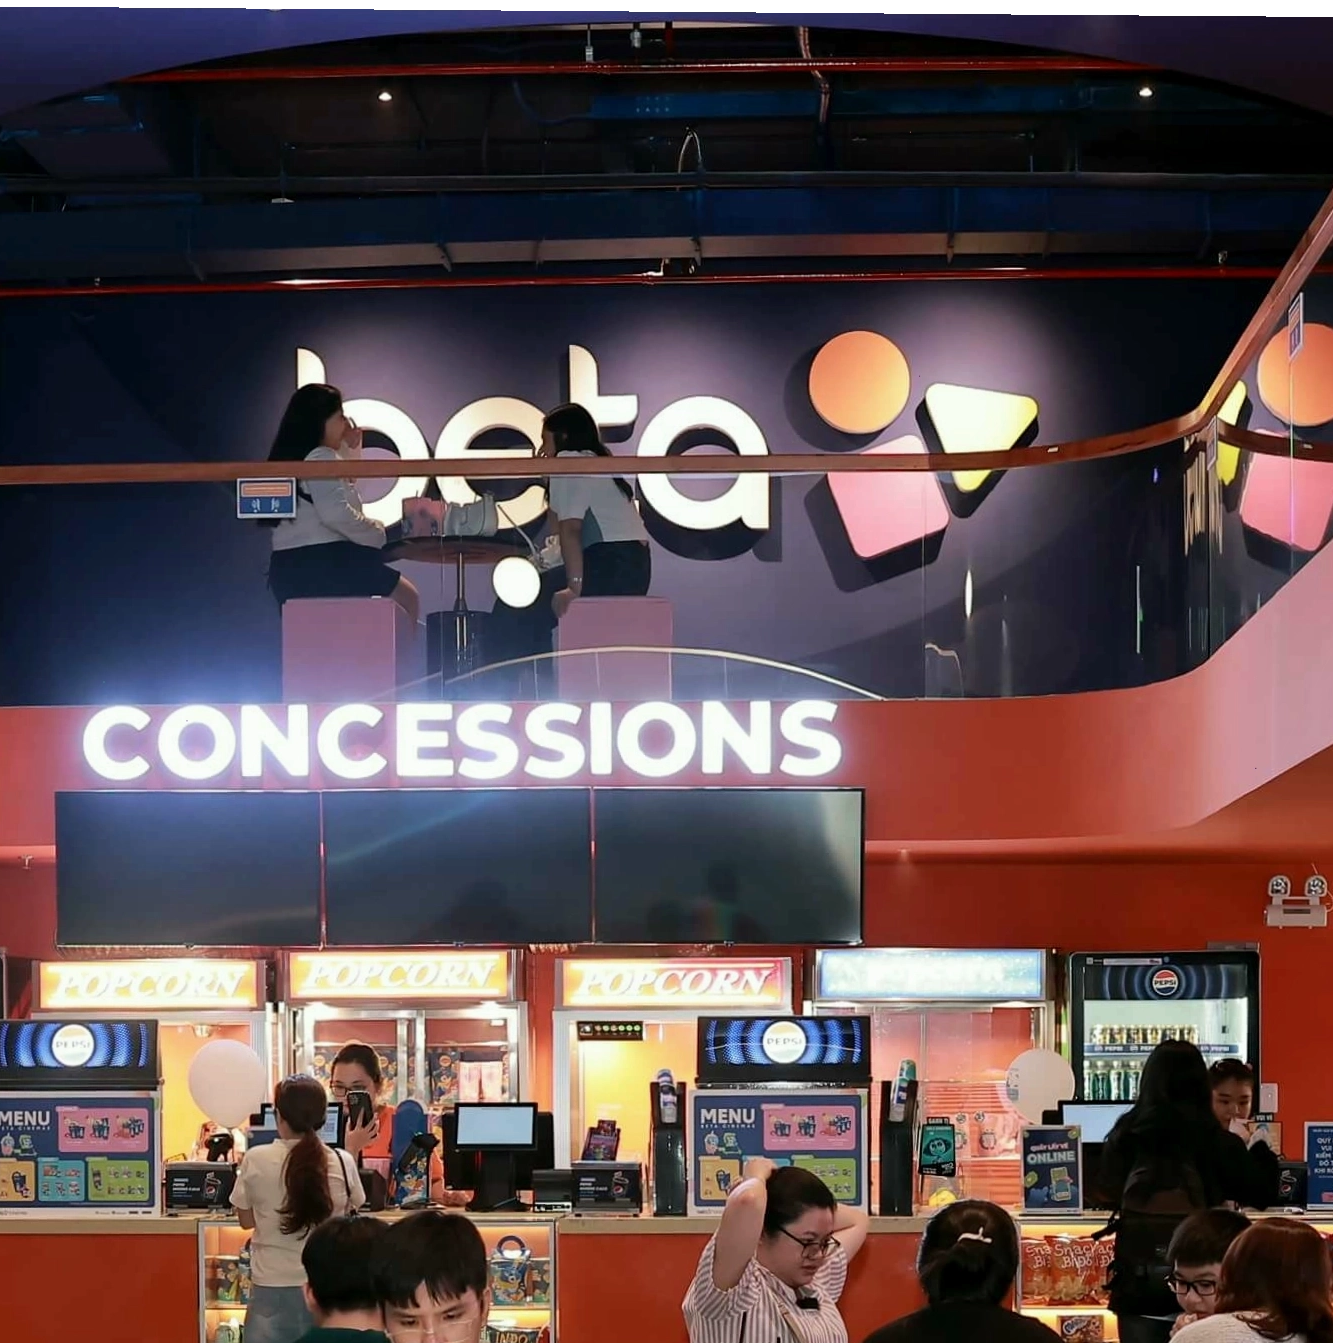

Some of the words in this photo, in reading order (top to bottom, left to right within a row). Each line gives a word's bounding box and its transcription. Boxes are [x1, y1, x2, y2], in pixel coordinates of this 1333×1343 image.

[83, 701, 842, 781] CONCESSIONS
[53, 964, 247, 998] POPCORN
[303, 957, 497, 988] POPCORN
[578, 968, 773, 997] POPCORN
[56, 1040, 90, 1049] PEPSI
[767, 1036, 803, 1047] PEPSI
[700, 1108, 755, 1124] MENU
[1027, 1151, 1076, 1164] ONLINE
